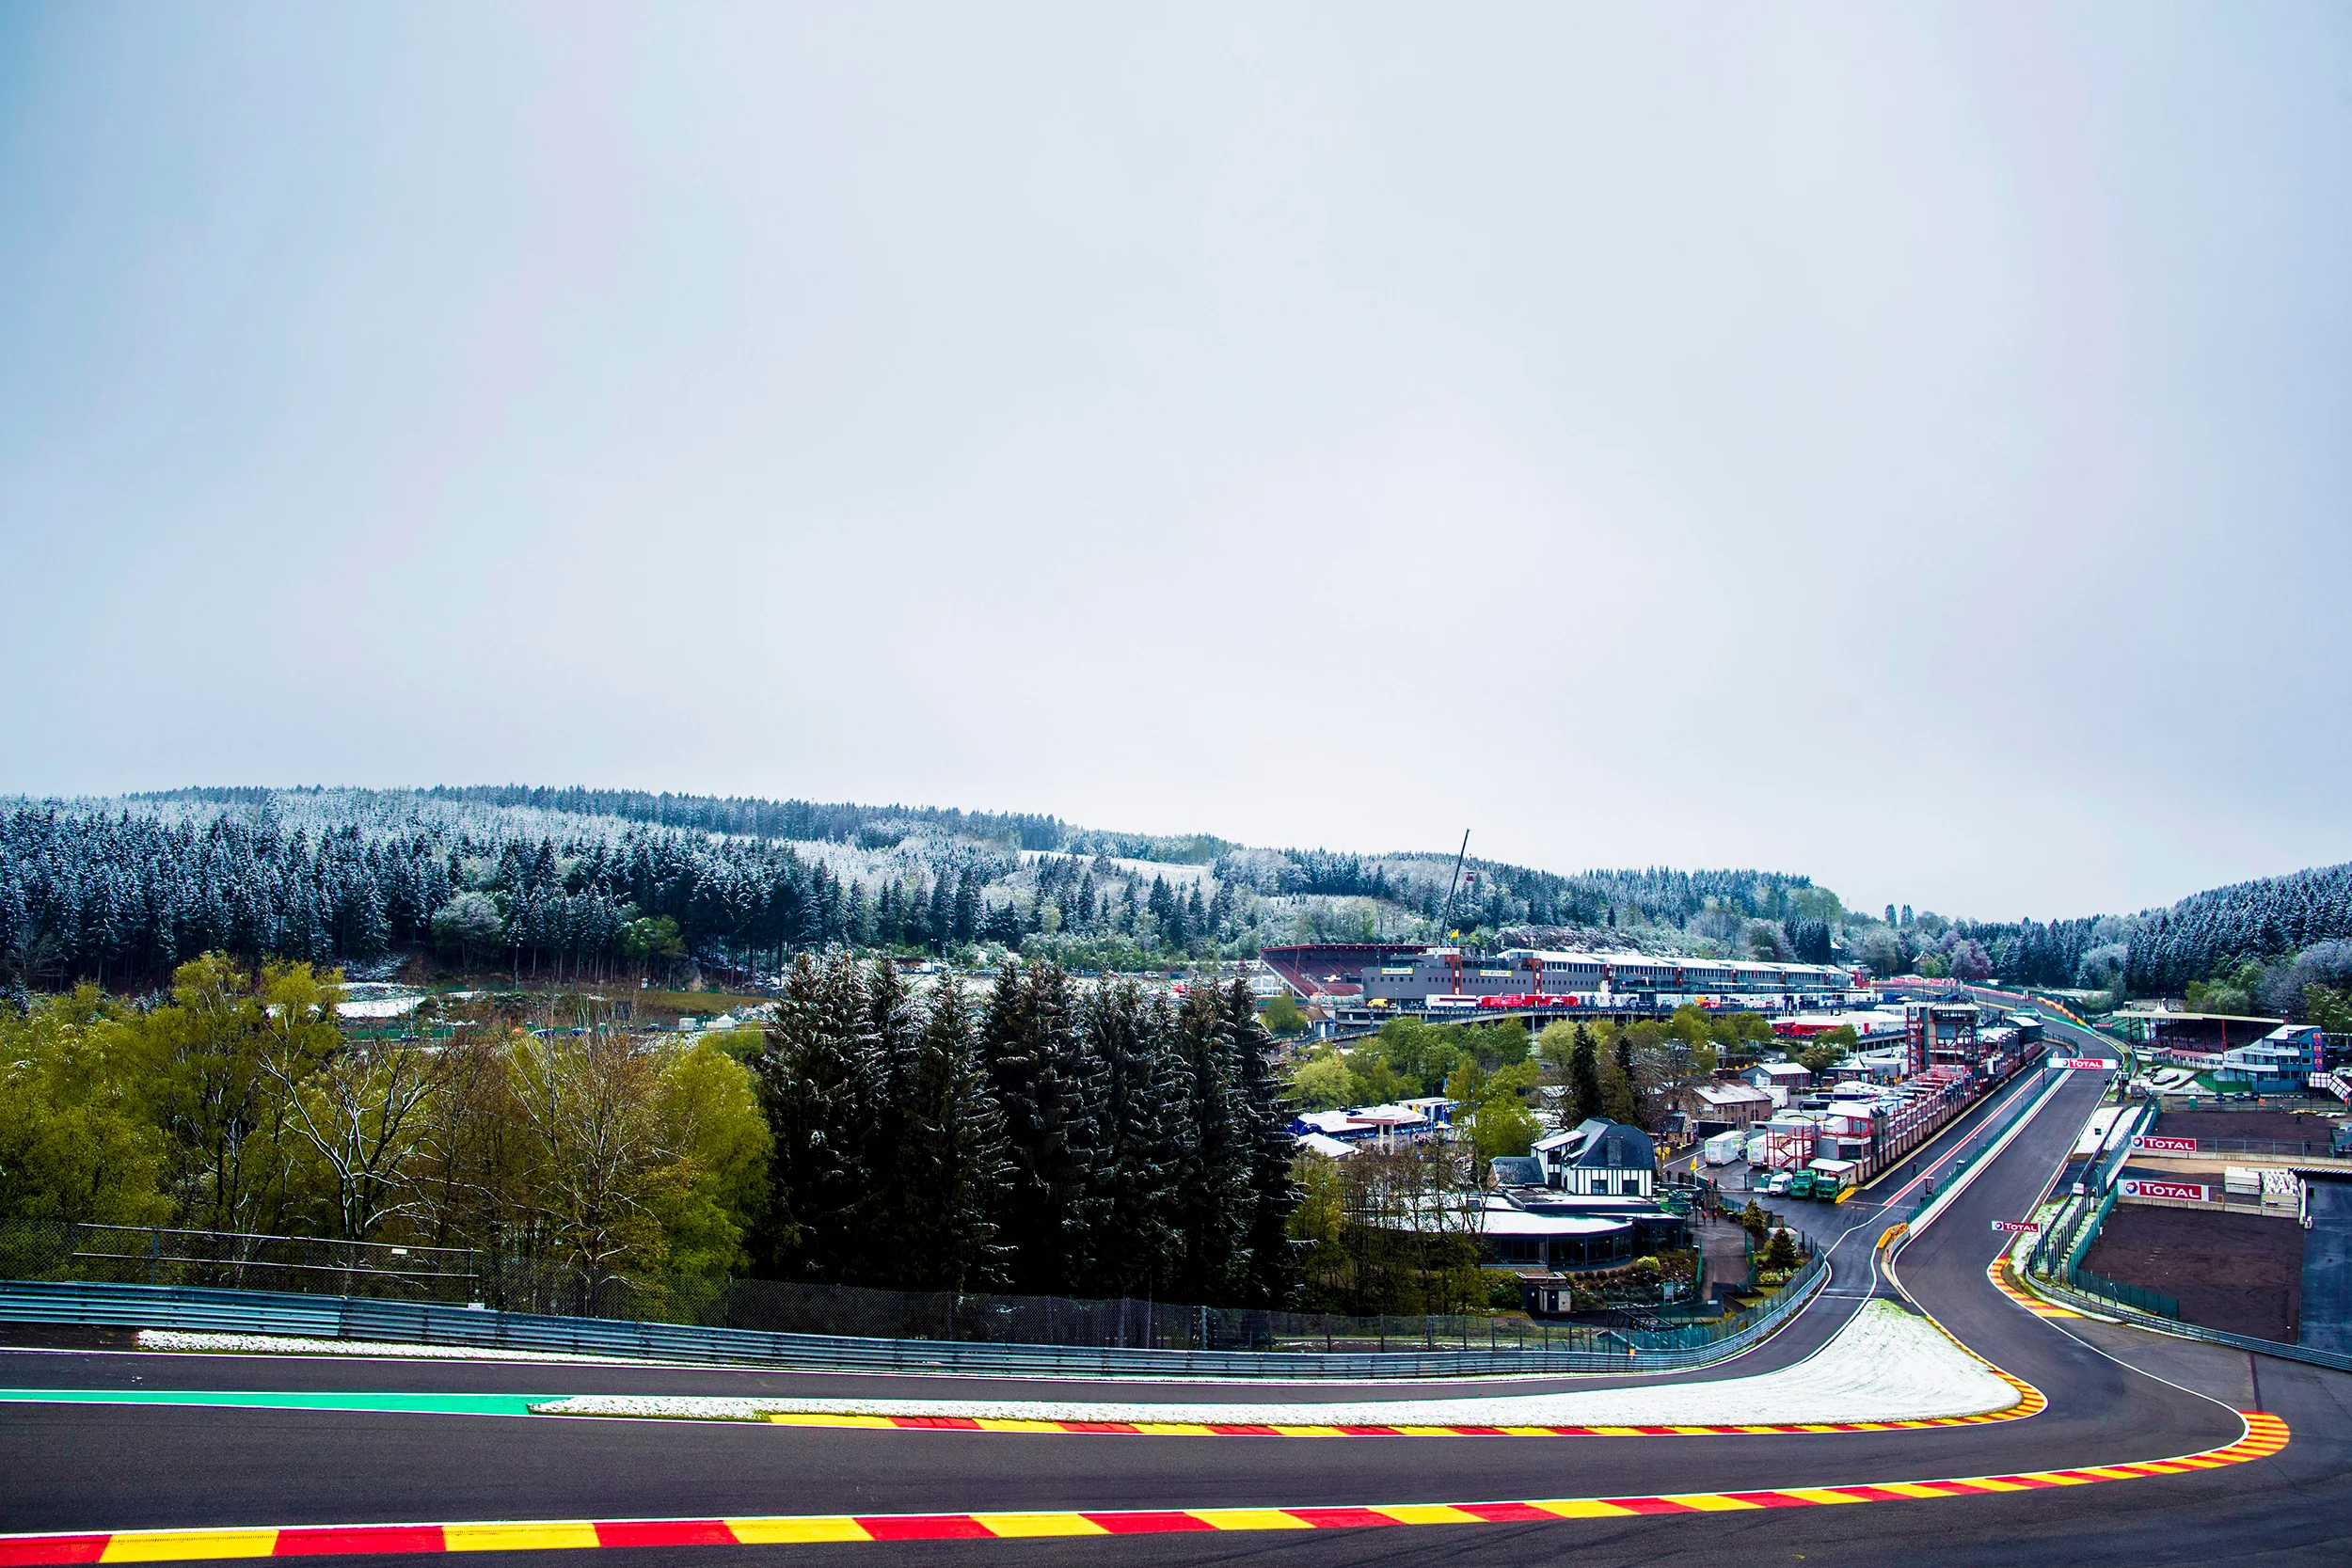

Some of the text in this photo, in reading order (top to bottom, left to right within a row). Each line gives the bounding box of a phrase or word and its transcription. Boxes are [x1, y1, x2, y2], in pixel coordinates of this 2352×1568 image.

[2146, 1138, 2194, 1150] TOTAL
[2142, 1183, 2200, 1198] TOTAL
[2005, 1223, 2037, 1231] TOTAL
